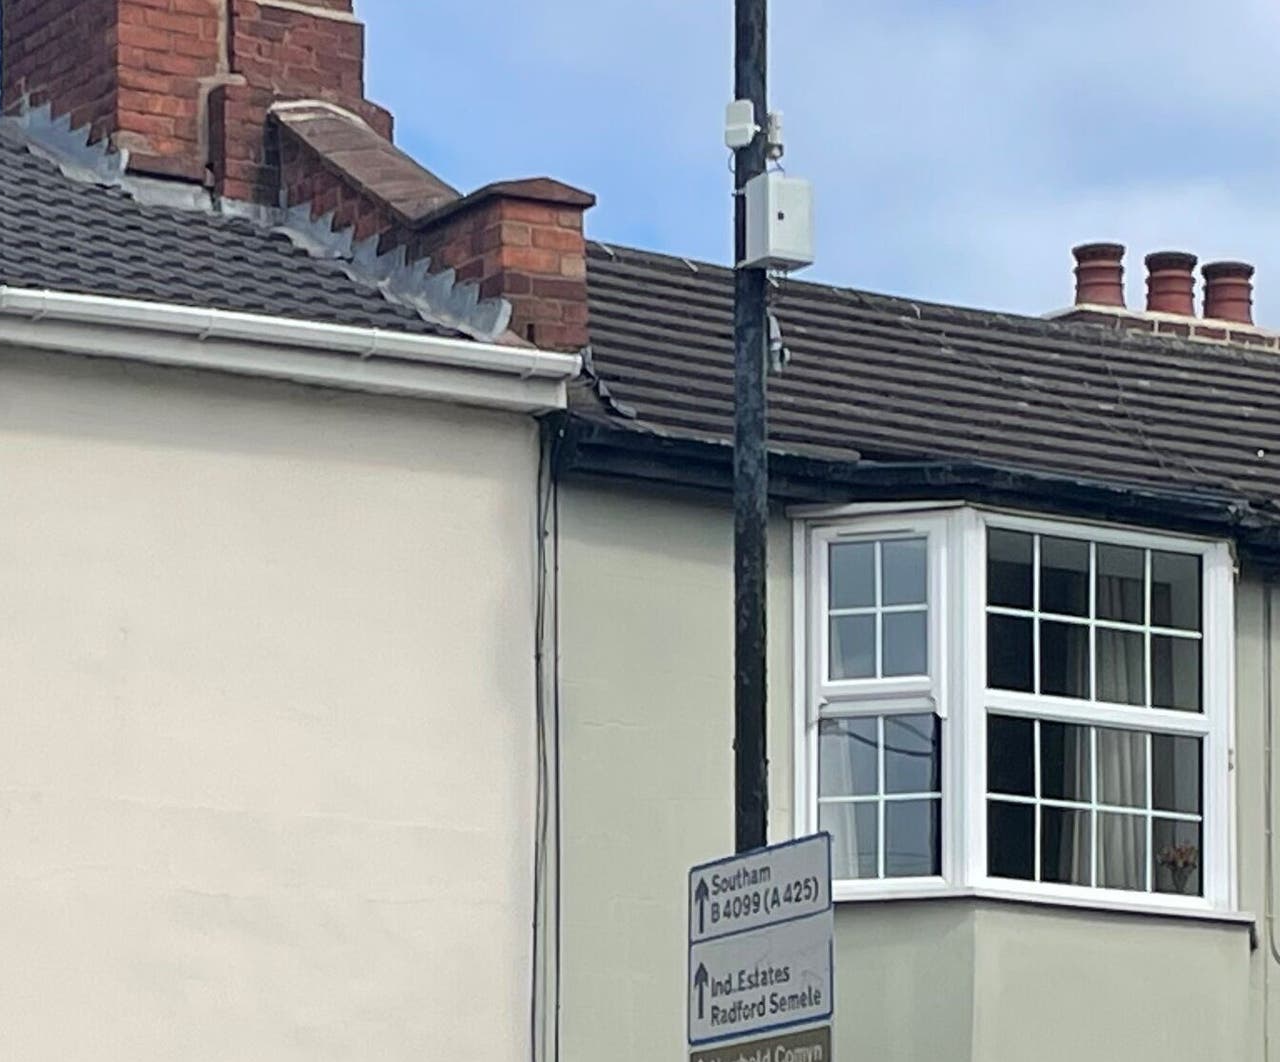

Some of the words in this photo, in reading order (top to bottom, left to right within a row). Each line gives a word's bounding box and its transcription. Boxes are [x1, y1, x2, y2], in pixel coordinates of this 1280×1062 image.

[711, 866, 771, 896] Southam
[710, 995, 766, 1026] Radford
[769, 985, 822, 1014] Semele
